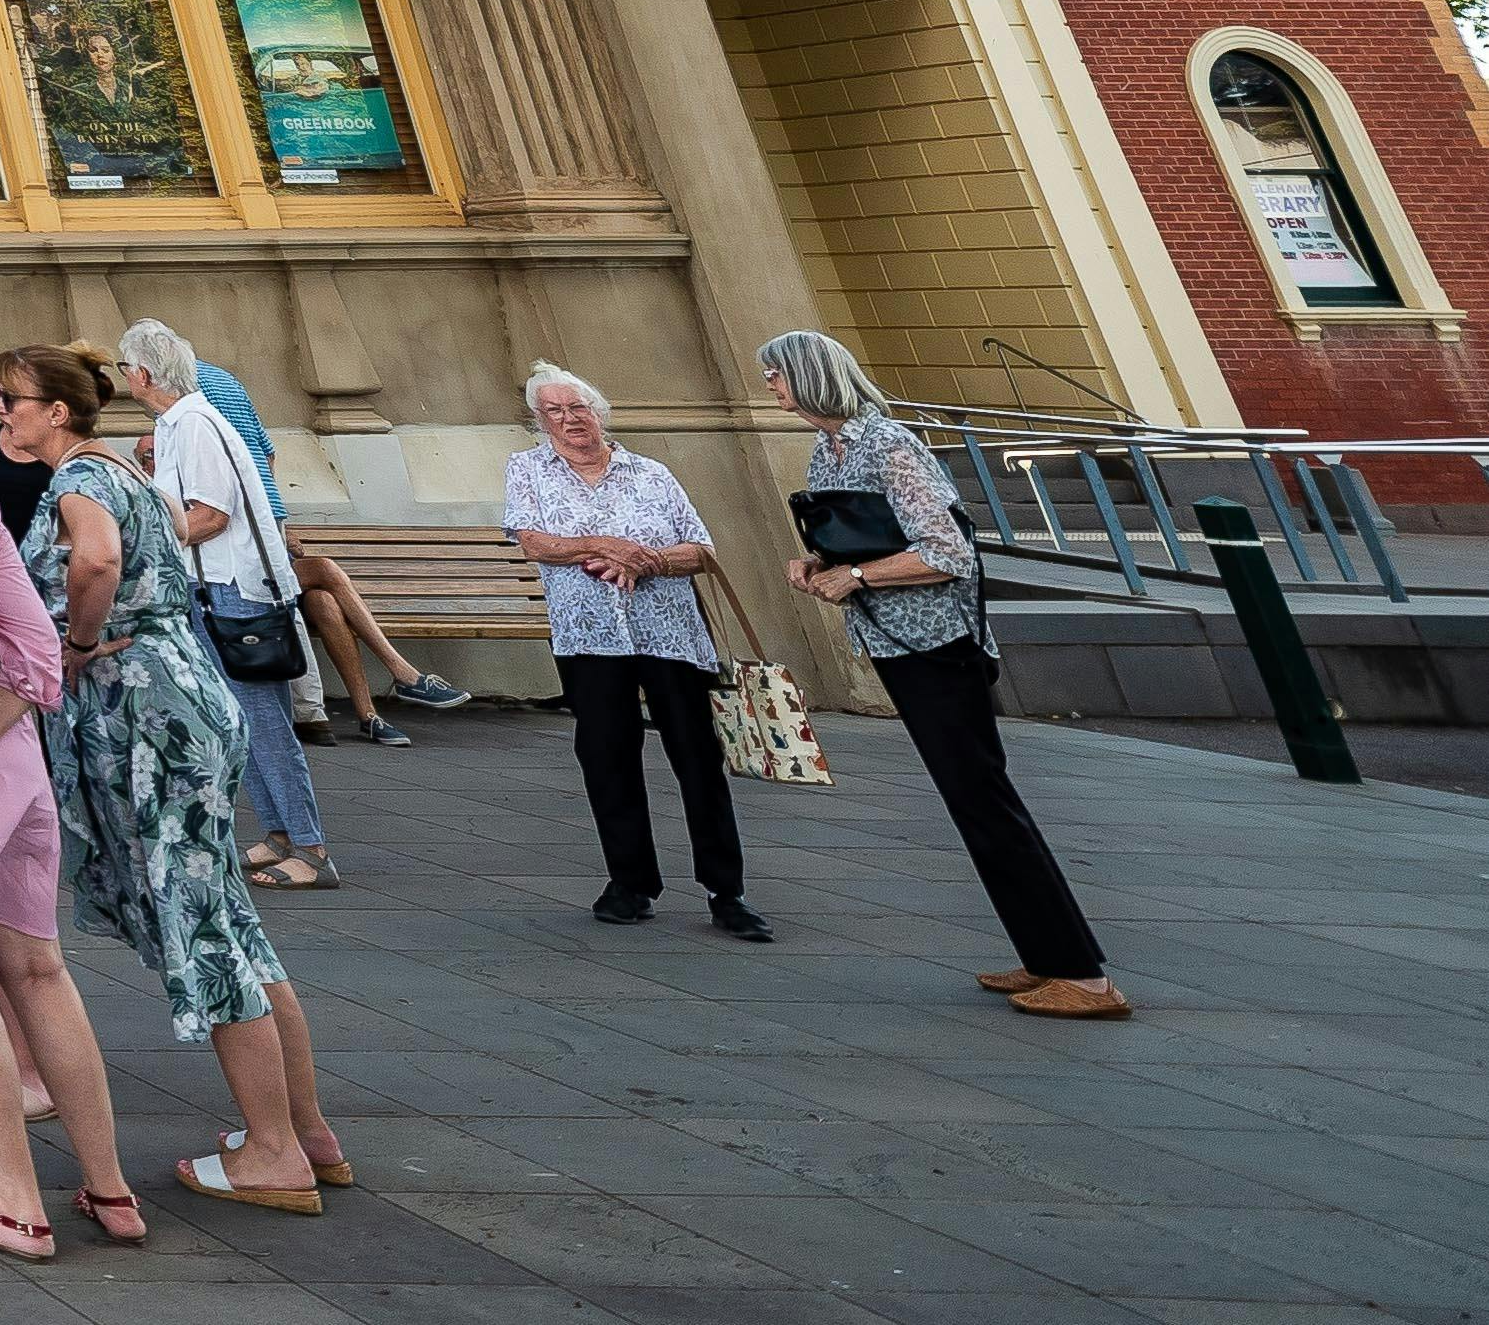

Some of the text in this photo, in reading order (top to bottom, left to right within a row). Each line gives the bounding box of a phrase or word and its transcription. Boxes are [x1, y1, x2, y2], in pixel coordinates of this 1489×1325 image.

[89, 122, 142, 132] ON THE
[282, 117, 377, 130] GREEN BOOK
[76, 134, 118, 144] BASIS
[1266, 217, 1309, 229] OPEN
